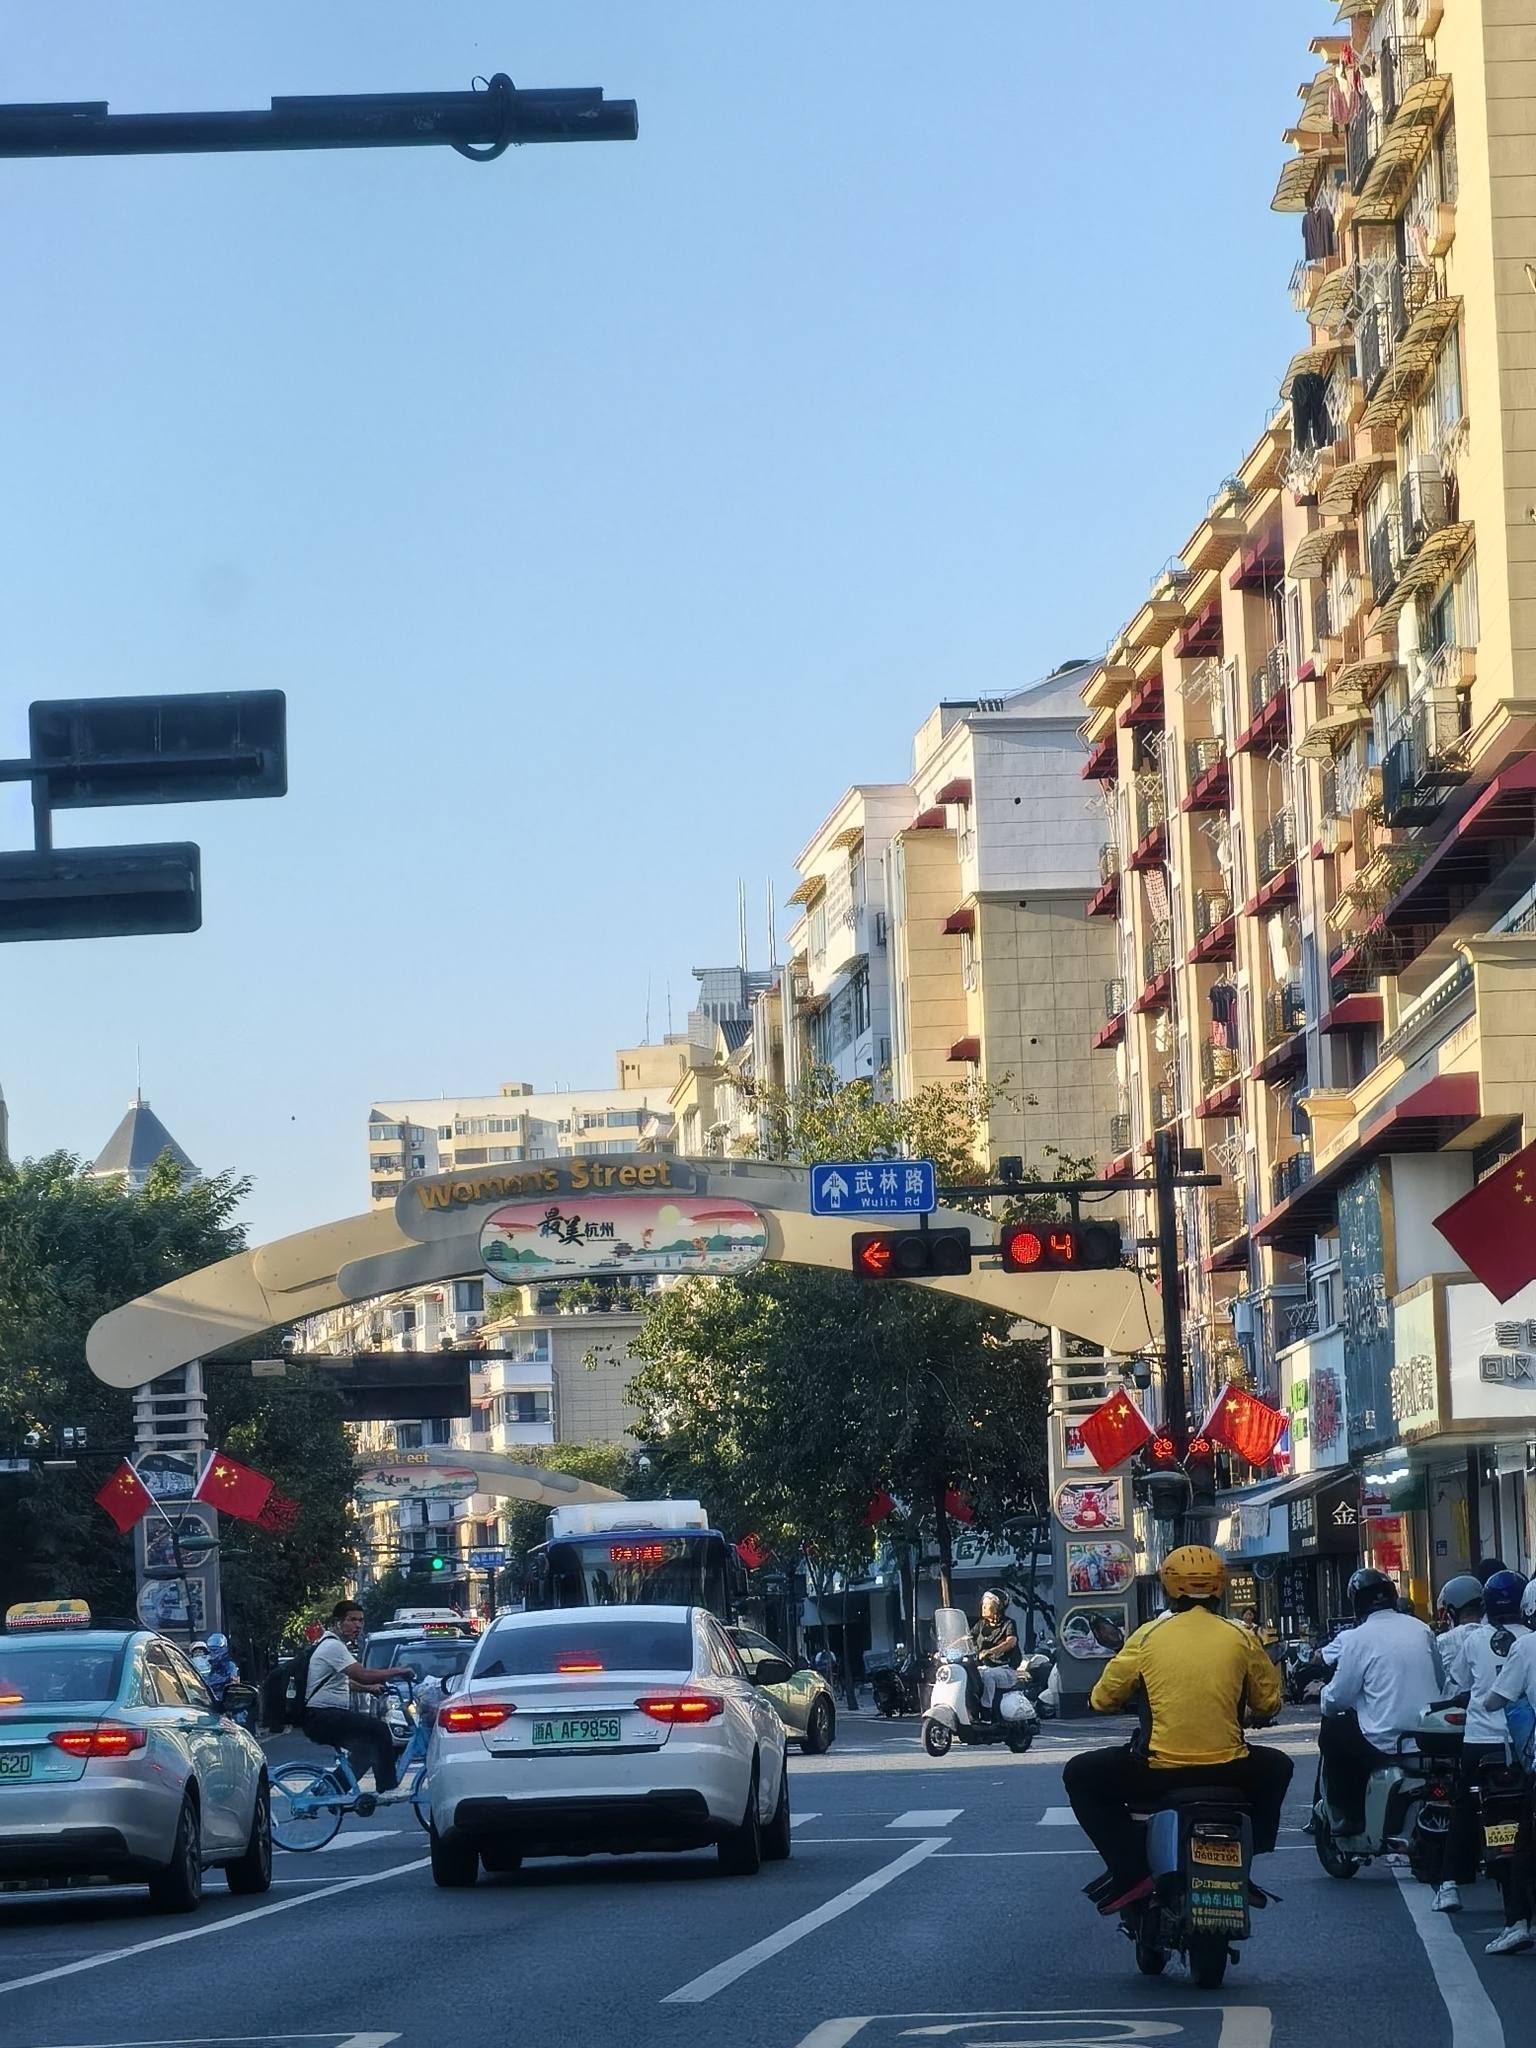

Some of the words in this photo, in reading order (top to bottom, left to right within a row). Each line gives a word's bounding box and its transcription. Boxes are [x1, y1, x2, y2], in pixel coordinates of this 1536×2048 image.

[416, 1166, 560, 1211] Women's
[570, 1158, 673, 1189] Street
[854, 1168, 924, 1195] 武林路
[861, 1197, 897, 1208] Wulin
[905, 1196, 920, 1207] Rd
[1049, 1232, 1072, 1260] 4
[1479, 1353, 1533, 1382] 回收
[1332, 1501, 1357, 1525] 金
[560, 1719, 619, 1738] AF9856
